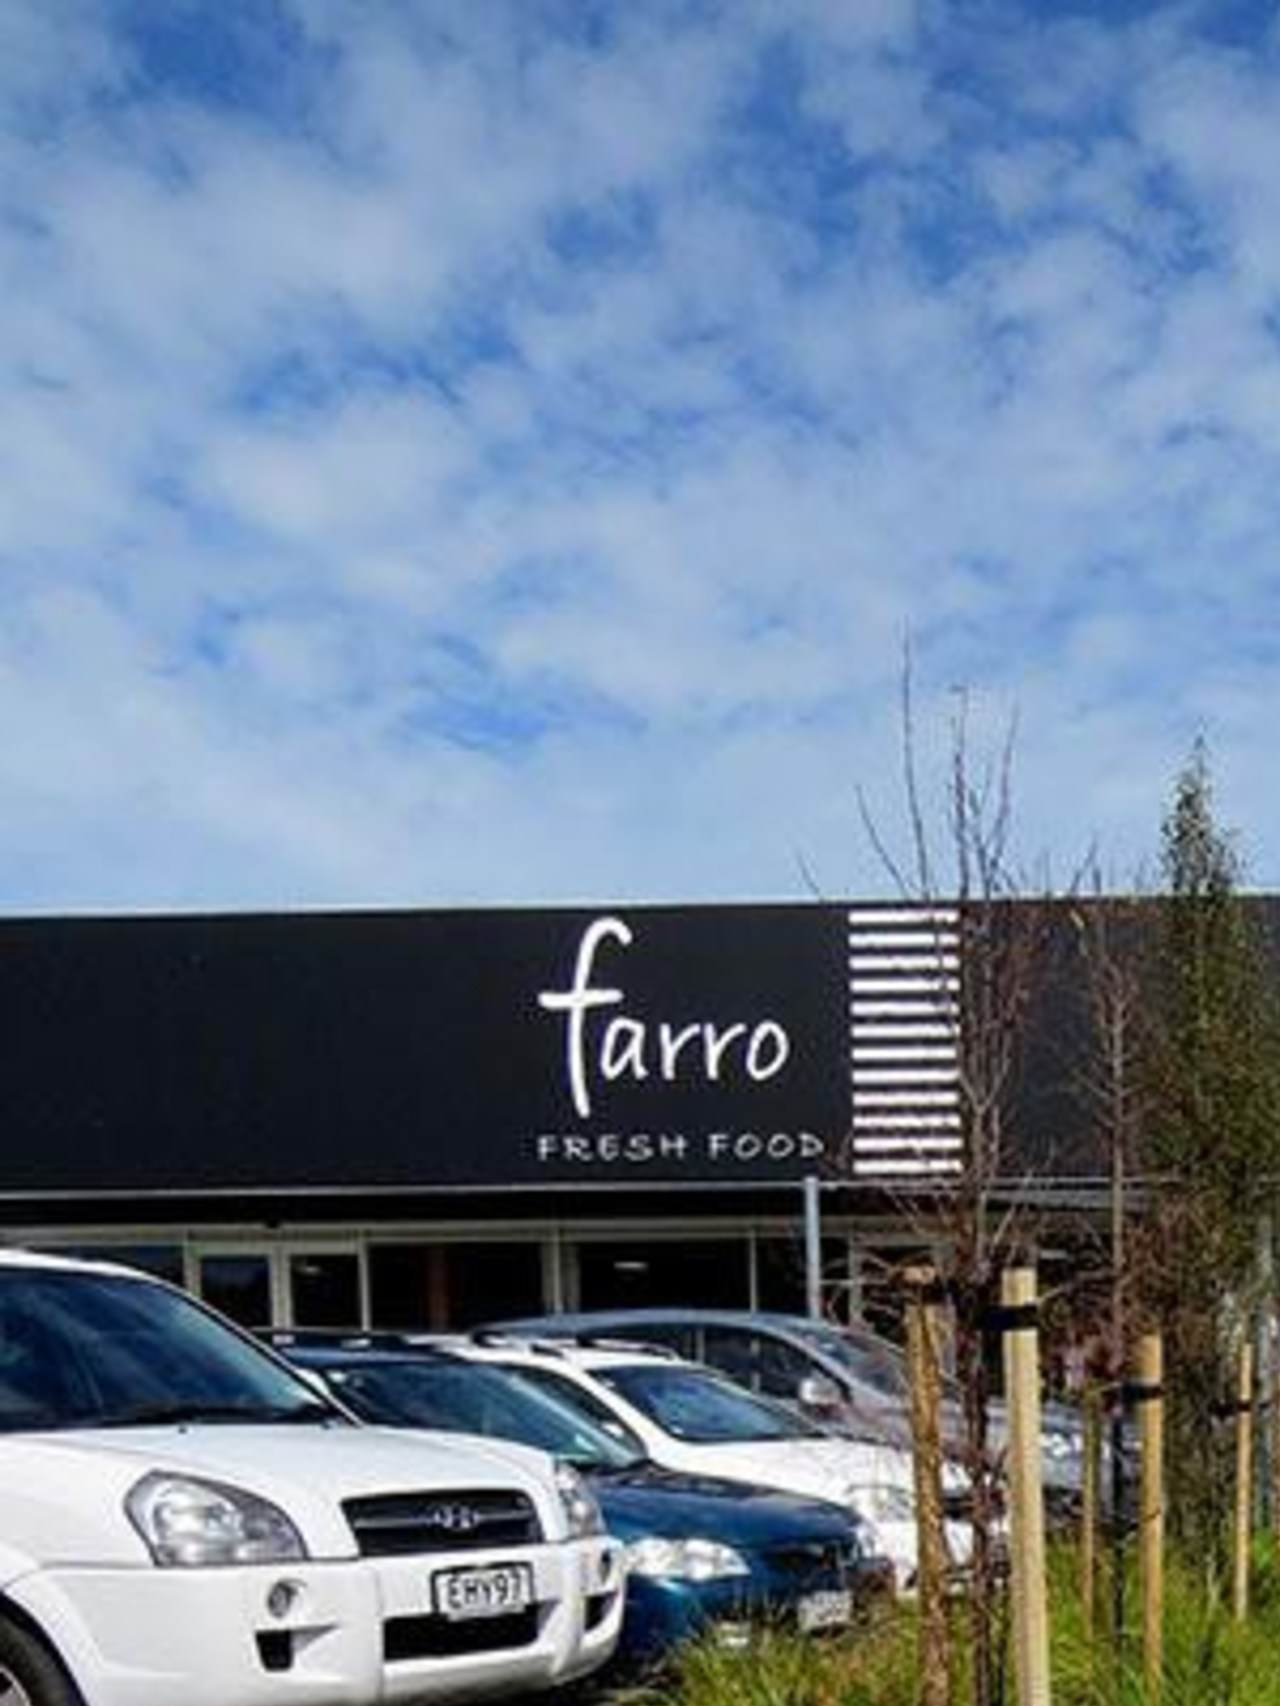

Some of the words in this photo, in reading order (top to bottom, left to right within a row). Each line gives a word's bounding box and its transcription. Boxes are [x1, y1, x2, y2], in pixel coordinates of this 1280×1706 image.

[538, 917, 789, 1118] farro
[538, 1134, 686, 1161] FRESH
[708, 1133, 824, 1159] FOOD
